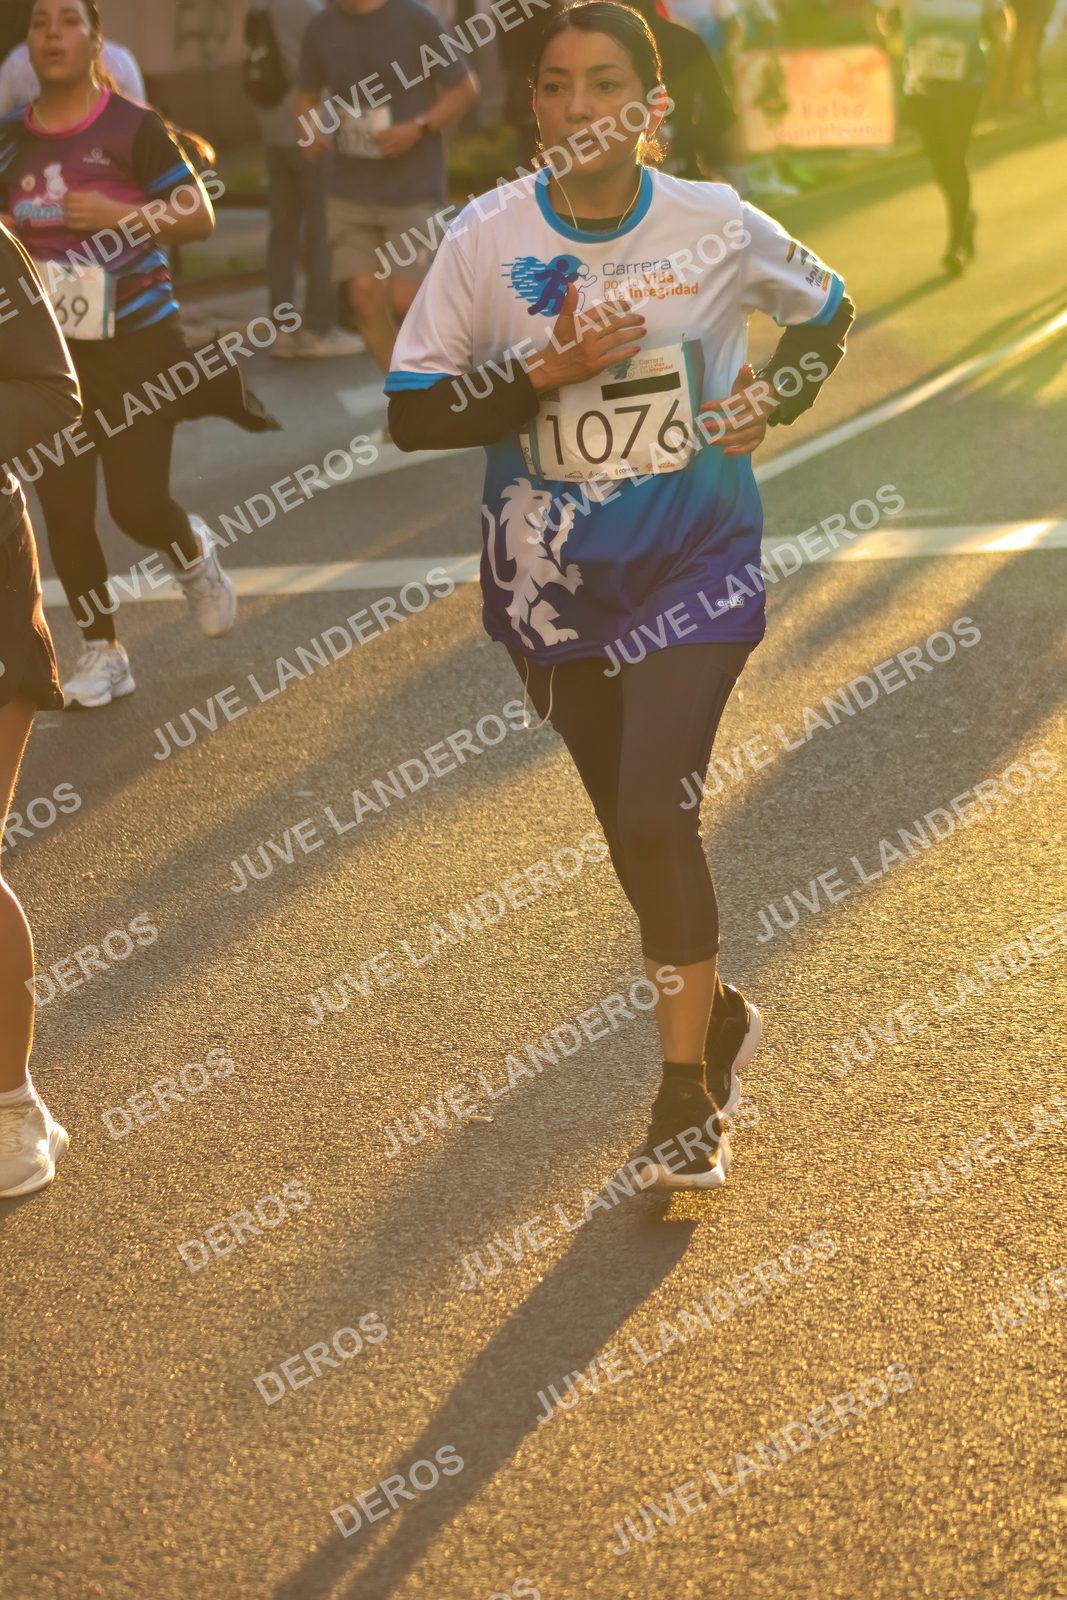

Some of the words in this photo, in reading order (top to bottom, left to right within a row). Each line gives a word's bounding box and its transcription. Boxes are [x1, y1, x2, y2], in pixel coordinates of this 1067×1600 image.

[602, 259, 672, 276] Carrera
[643, 271, 675, 285] Vida
[629, 282, 699, 300] Integridad
[546, 399, 689, 465] 1076
